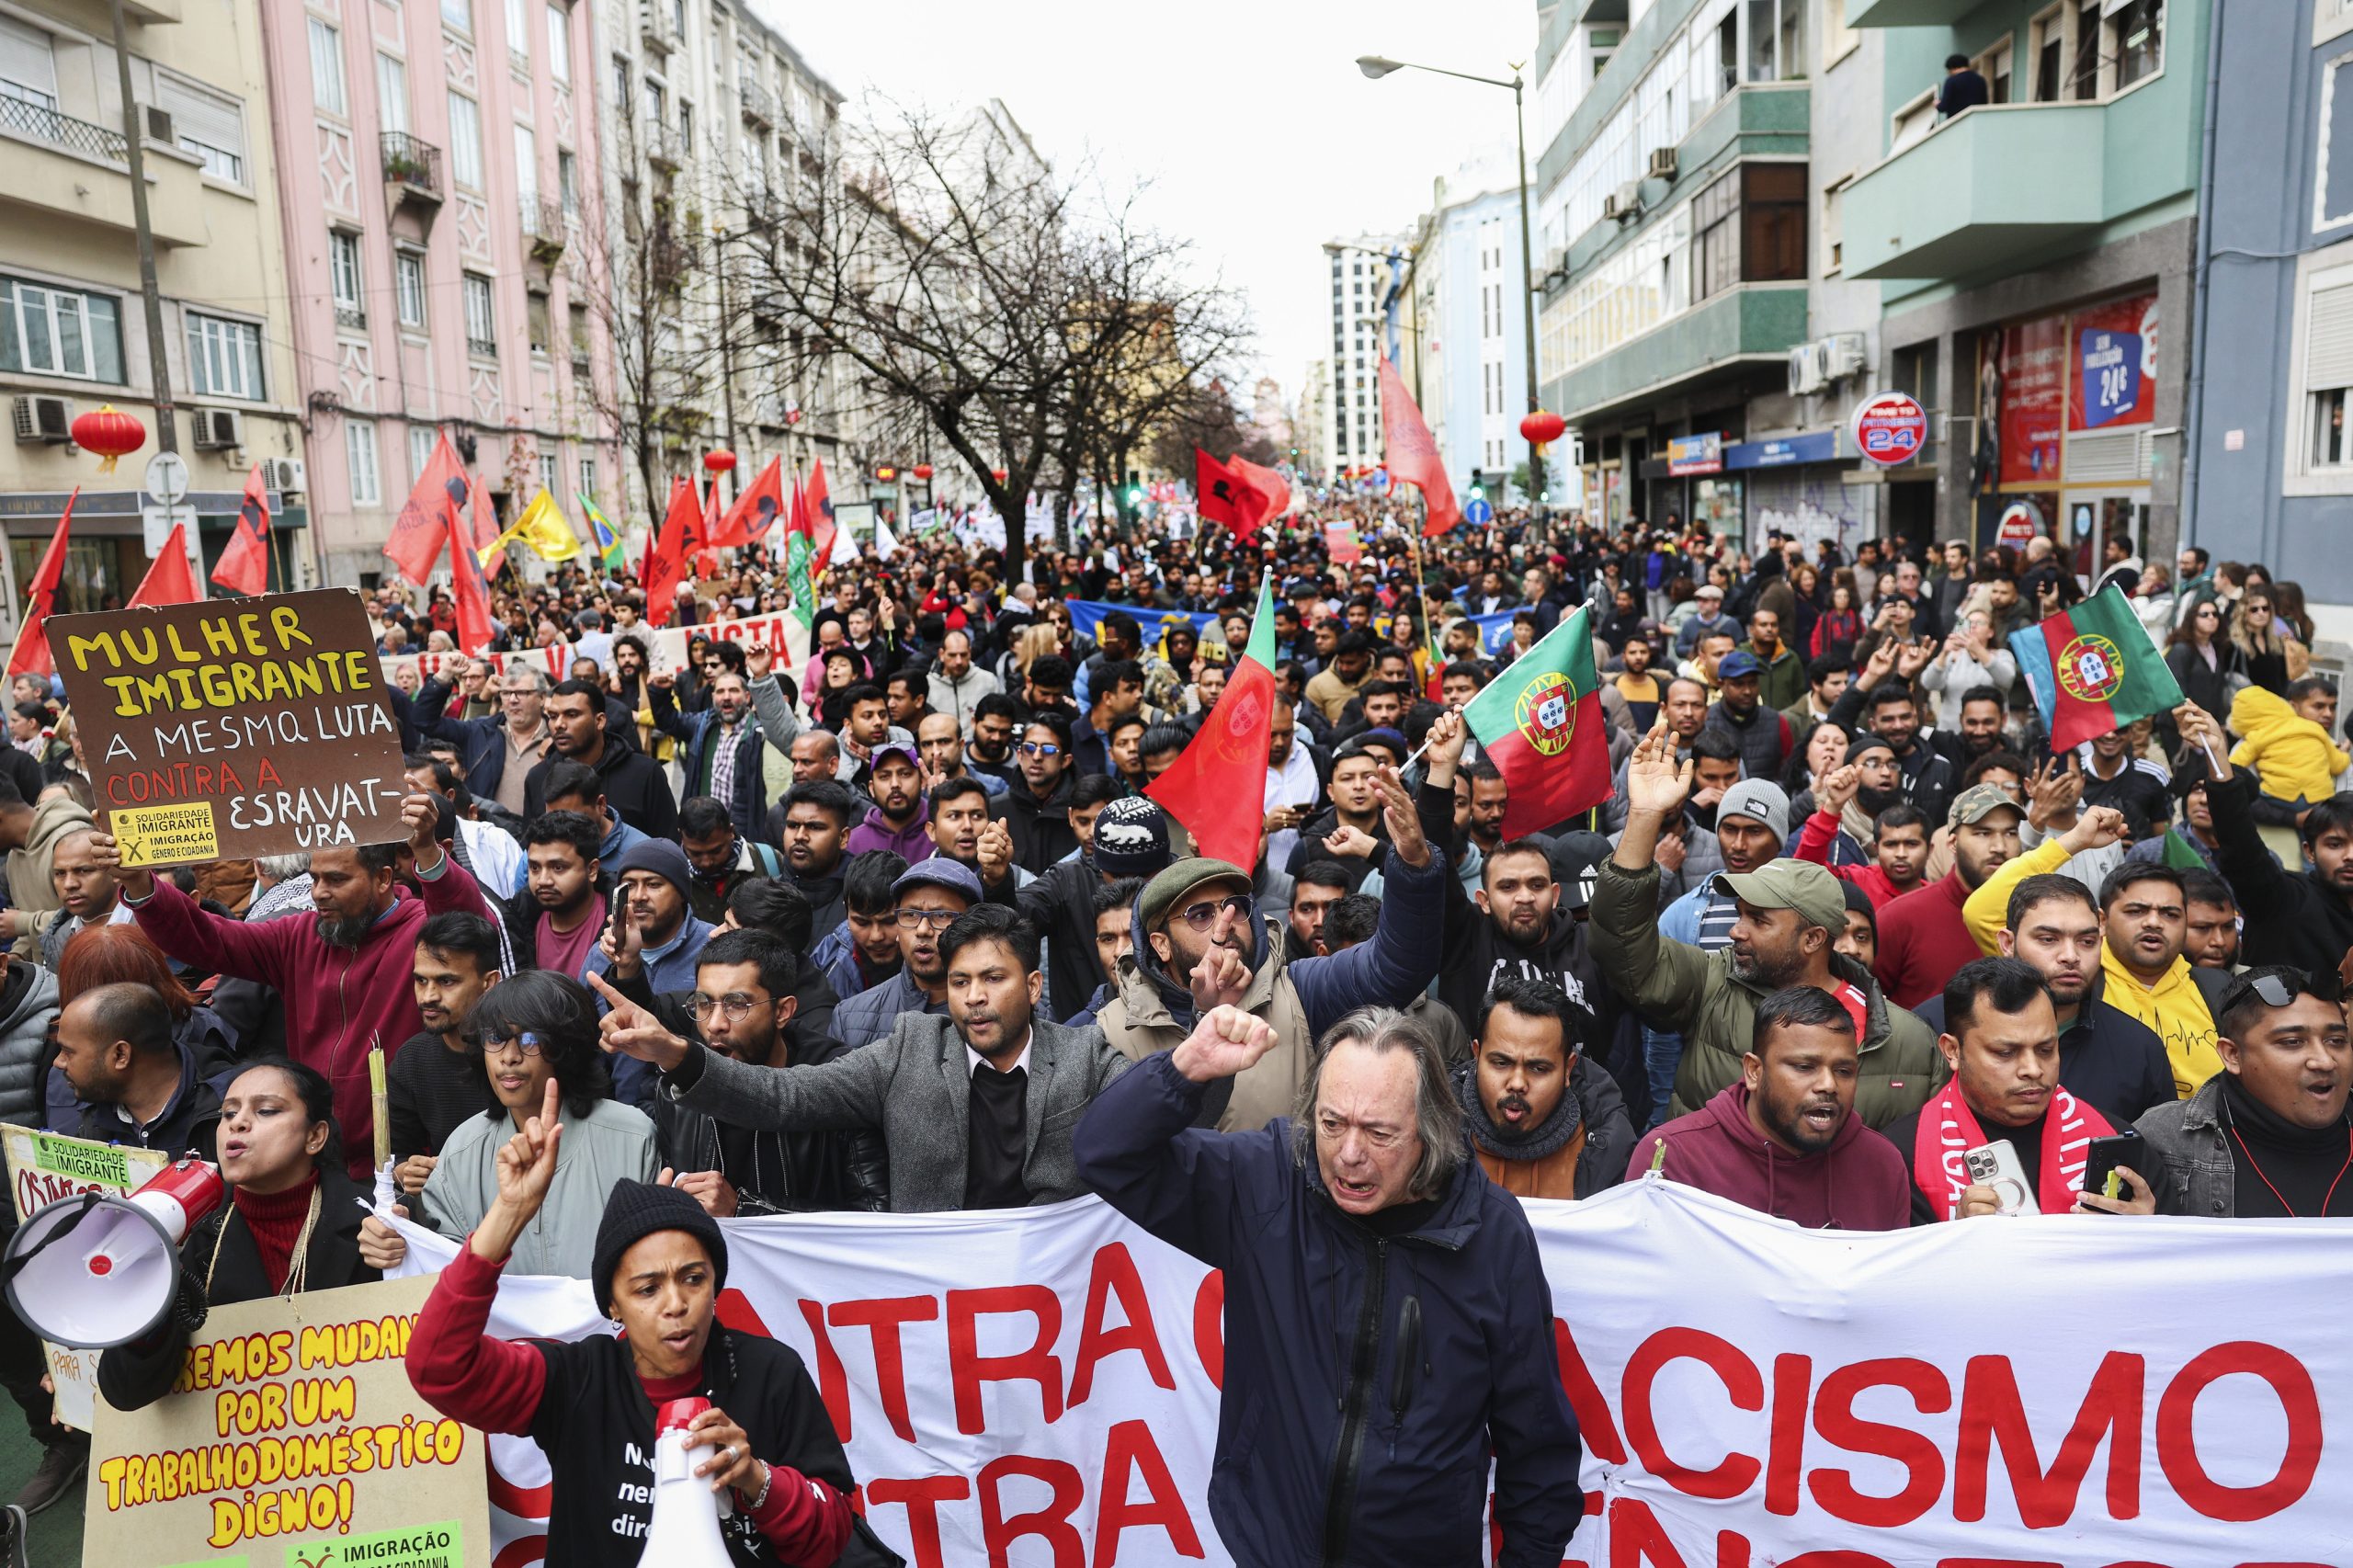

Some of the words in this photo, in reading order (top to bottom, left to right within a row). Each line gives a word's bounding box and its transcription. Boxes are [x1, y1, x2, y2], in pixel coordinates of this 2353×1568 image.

[1867, 427, 1918, 452] 24
[66, 605, 314, 673] MULHER
[102, 650, 373, 718] IMIGRANTE
[104, 733, 138, 765] A
[314, 702, 393, 742] LUTA
[107, 759, 255, 806] CONTRA
[256, 756, 284, 789] A
[135, 809, 210, 824] SOLIDARIEDADE
[137, 817, 211, 834] IMIGRANTE
[150, 832, 214, 846] IMIGRAÇÃO
[176, 847, 181, 856] E
[181, 844, 215, 857] CIDADANIA
[294, 823, 357, 848] URA
[52, 1142, 124, 1166] SOLIDARIEDADE
[55, 1154, 128, 1183] IMIGRANTE
[52, 1350, 81, 1381] PARA
[216, 1382, 287, 1437] POR
[290, 1375, 356, 1427] UM
[99, 1442, 258, 1512] TRABALHO
[344, 1531, 450, 1562] IMIGRAÇÃO
